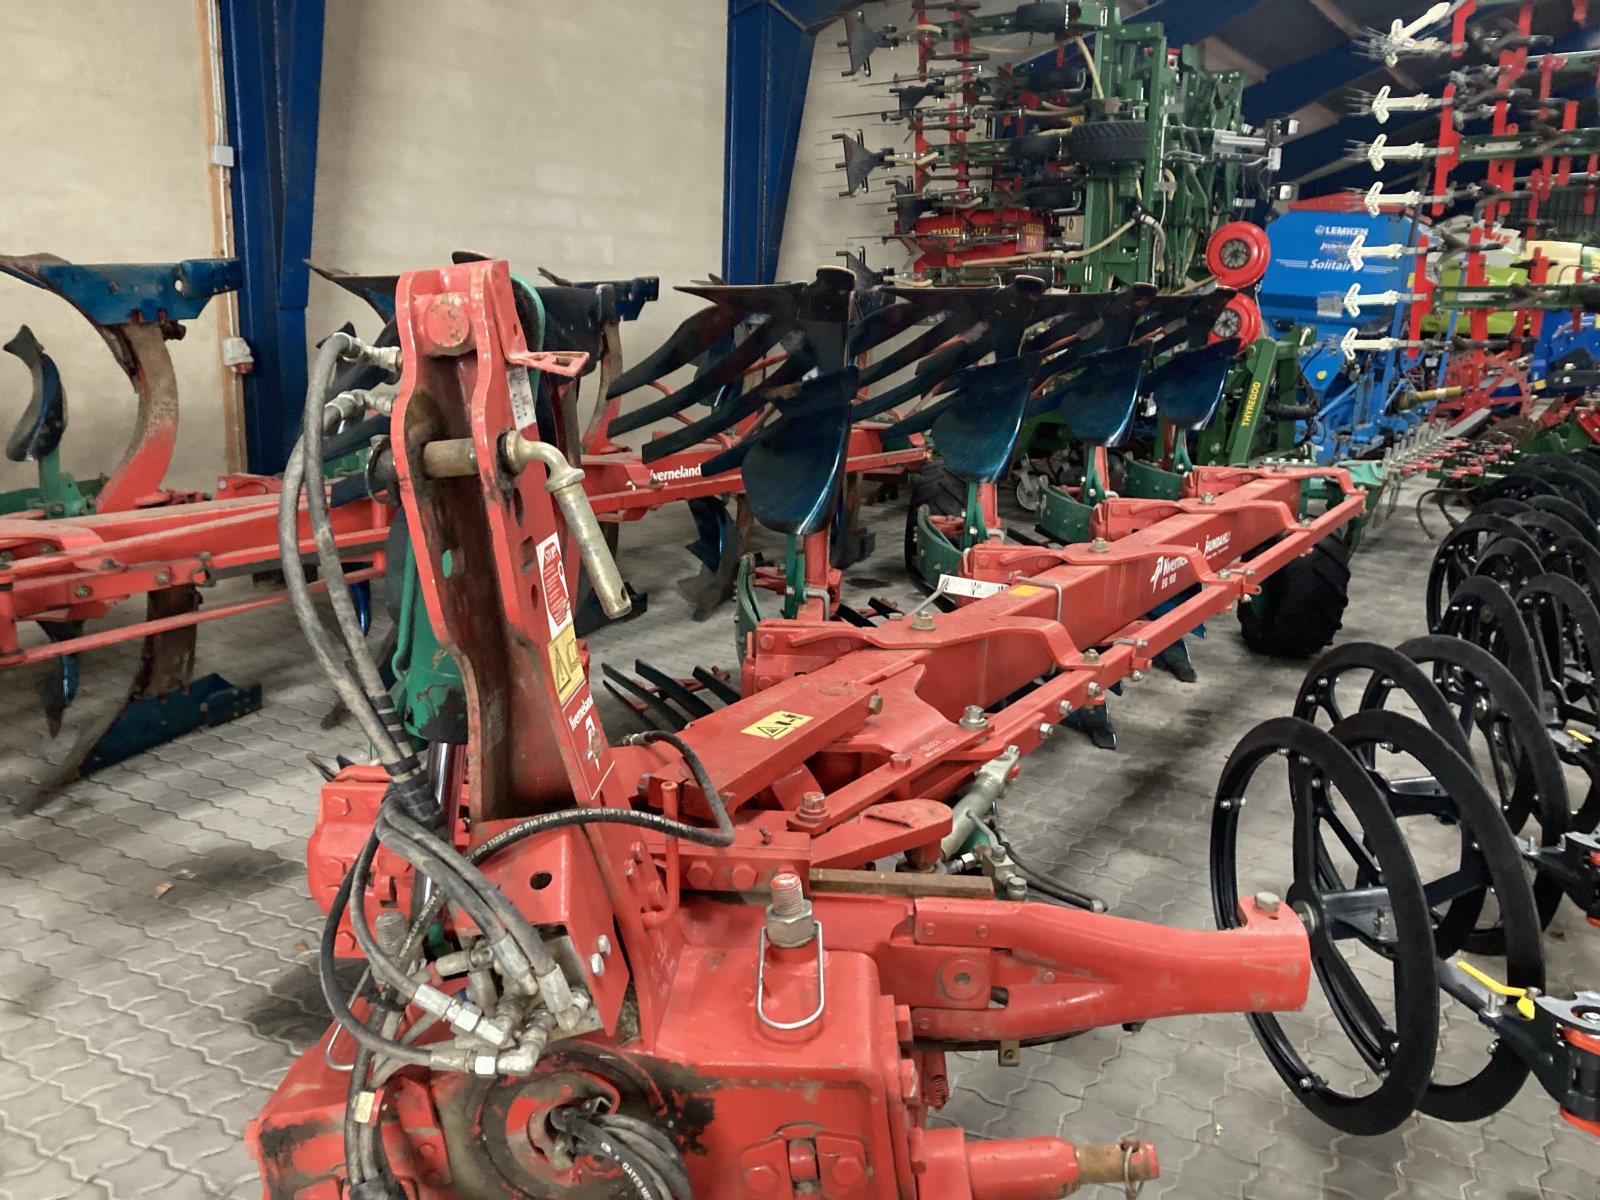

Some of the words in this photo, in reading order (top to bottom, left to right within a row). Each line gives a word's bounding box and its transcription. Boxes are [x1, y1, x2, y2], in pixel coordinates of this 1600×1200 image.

[1325, 226, 1369, 236] LEMKEN
[1310, 259, 1351, 271] Solitair
[1241, 381, 1261, 427] THYREGOD
[544, 814, 560, 823] SAE
[622, 1162, 643, 1188] GATES
